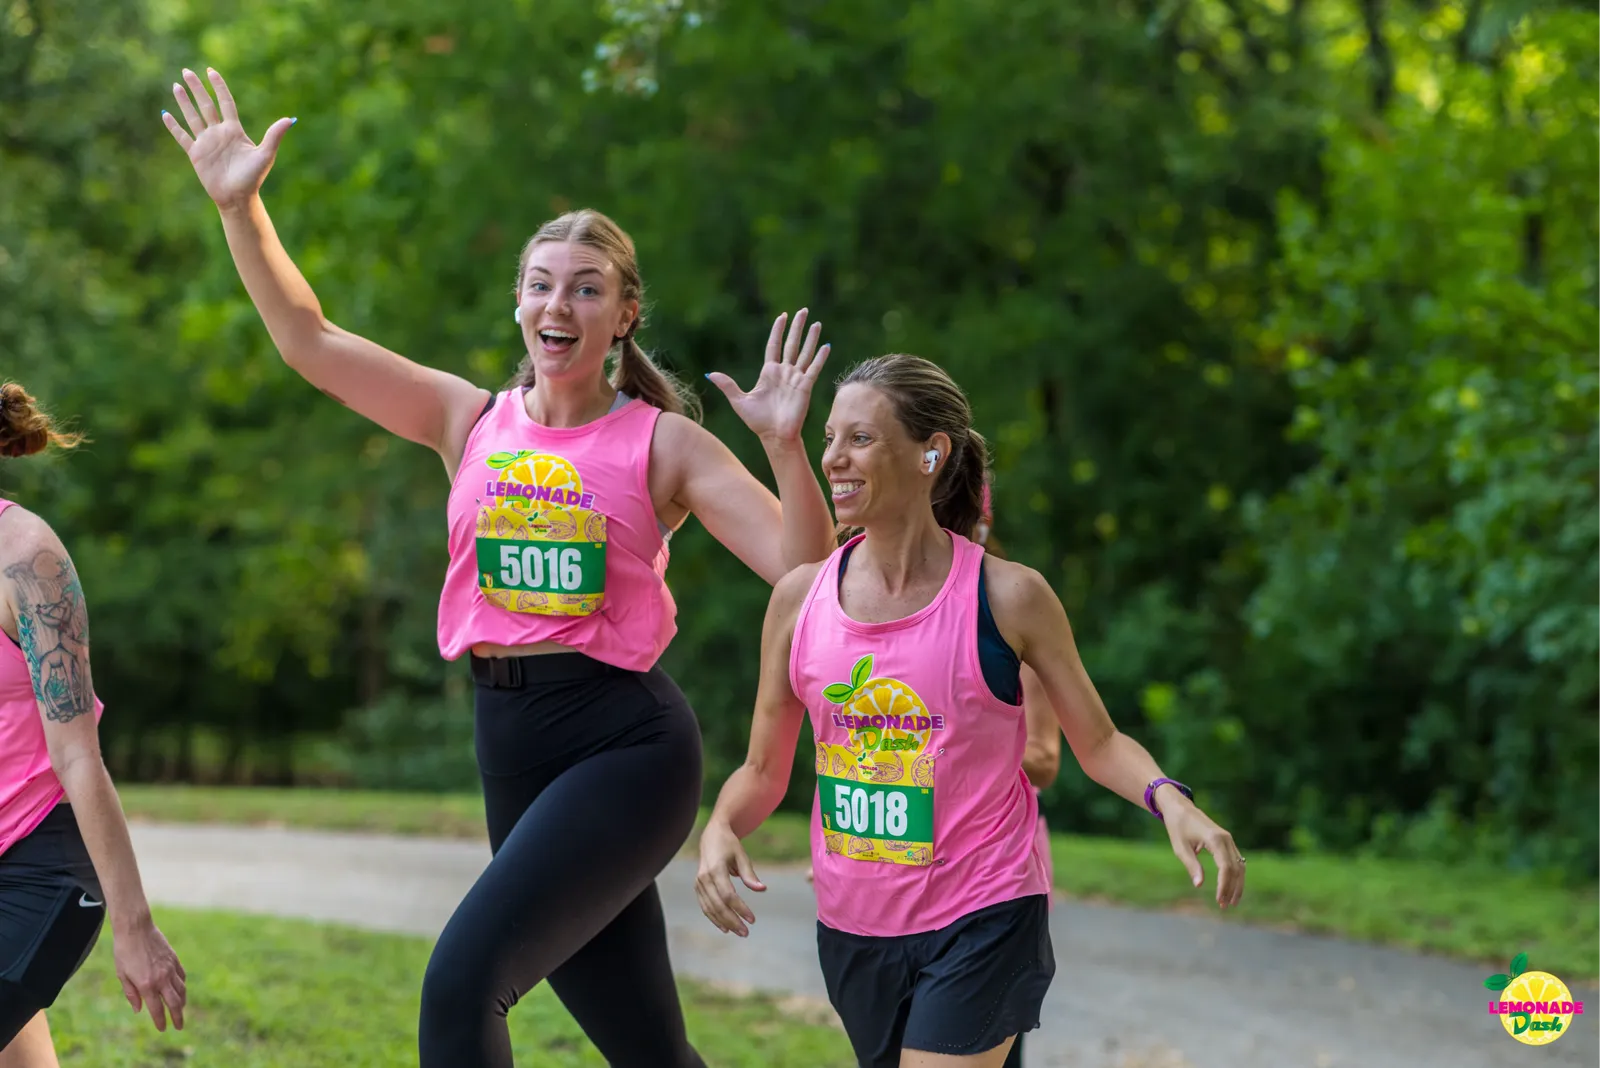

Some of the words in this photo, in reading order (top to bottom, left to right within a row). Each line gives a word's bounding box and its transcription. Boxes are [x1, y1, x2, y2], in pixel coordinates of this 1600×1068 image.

[486, 481, 594, 509] LEMONADE
[499, 544, 582, 591] 5016
[832, 713, 944, 731] LEMONADE
[856, 725, 920, 752] Dash
[834, 783, 908, 837] 5018
